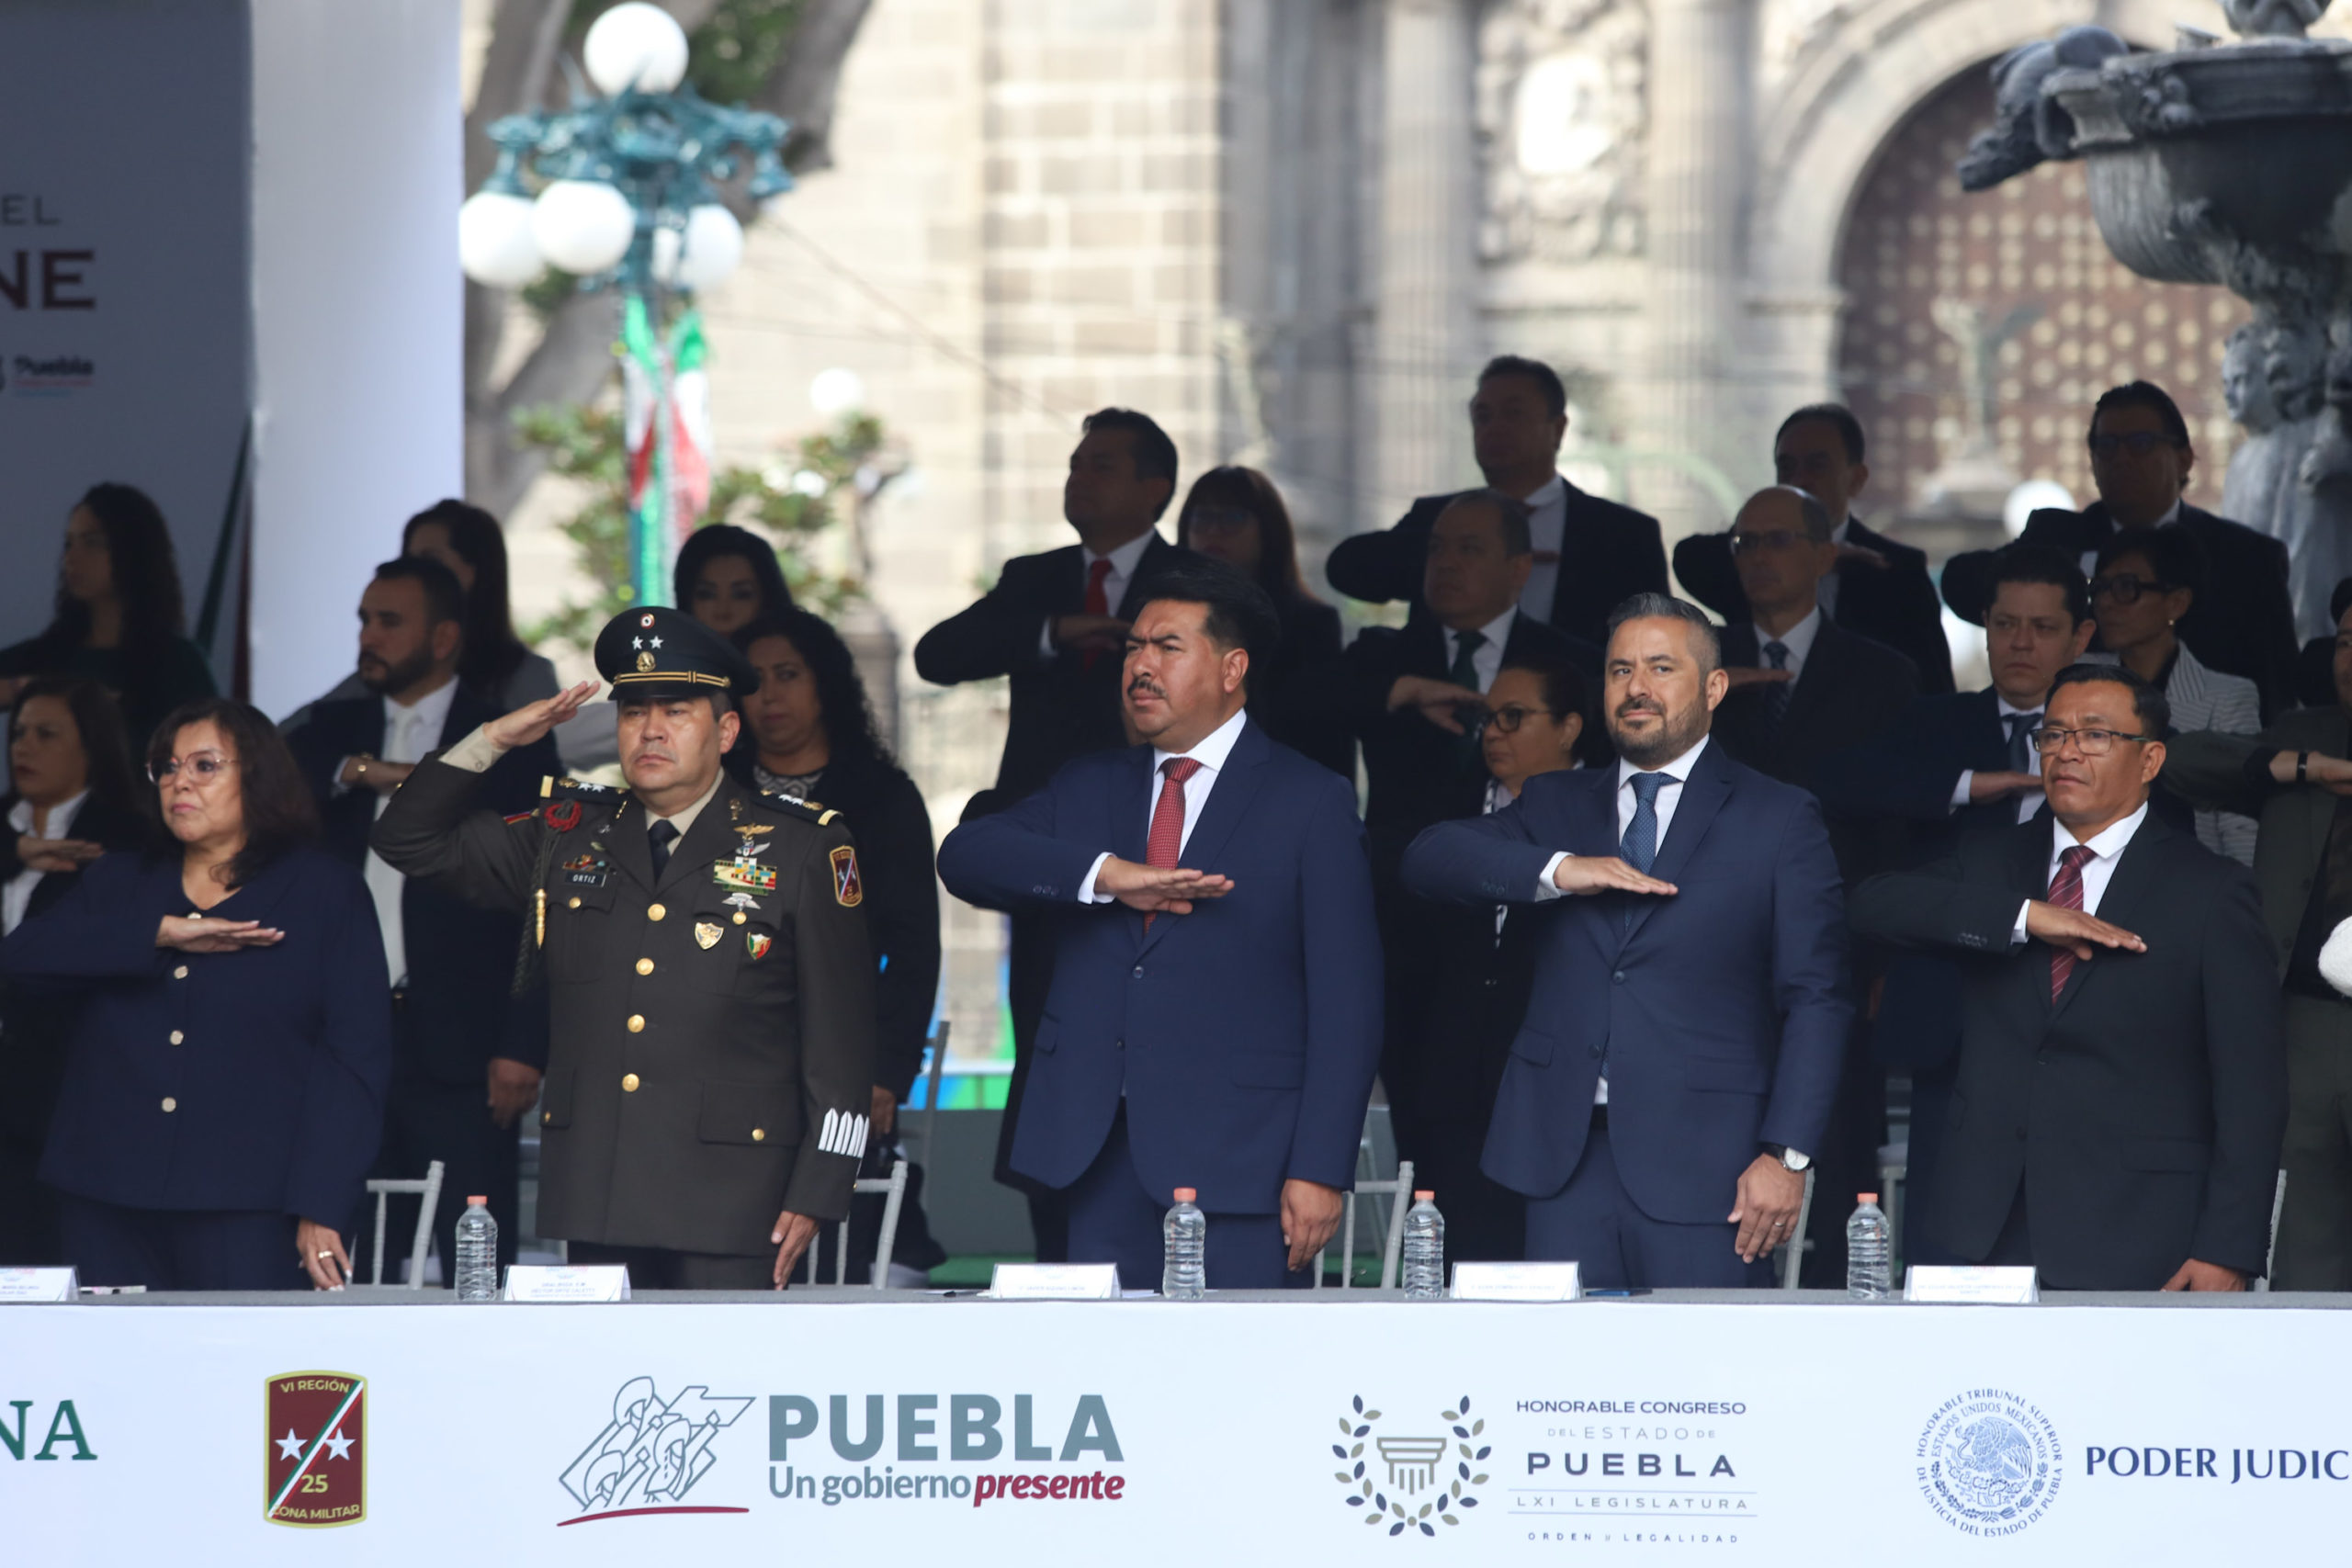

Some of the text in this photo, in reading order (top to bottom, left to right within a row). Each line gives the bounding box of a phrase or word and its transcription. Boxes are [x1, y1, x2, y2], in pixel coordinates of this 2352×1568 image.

[572, 874, 596, 884] ORTIZ
[280, 1379, 350, 1393] VI REGIÓN
[1517, 1401, 1747, 1415] HONORABLE CONGRESO
[769, 1394, 1125, 1461] PUEBLA
[1548, 1427, 1715, 1440] DEL ESTADO DE
[1917, 1388, 2063, 1461] HONORABLE TRIBUNAL SUPERIOR
[1931, 1402, 2048, 1460] ESTADOS UNIDOS MEXICANOS
[1528, 1452, 1736, 1477] PUEBLA
[2086, 1447, 2349, 1484] PODER JUDIC
[300, 1474, 328, 1494] 25
[769, 1465, 1125, 1507] Un gobierno presente
[311, 1505, 360, 1519] MILITAR
[1517, 1497, 1747, 1509] LXI LEGISLATURA
[1917, 1467, 2063, 1537] DE JUSTICIA DEL ESTADO DE PUEBLA
[1528, 1533, 1591, 1541] ORDEN
[1623, 1534, 1737, 1543] LEGALIDAD
